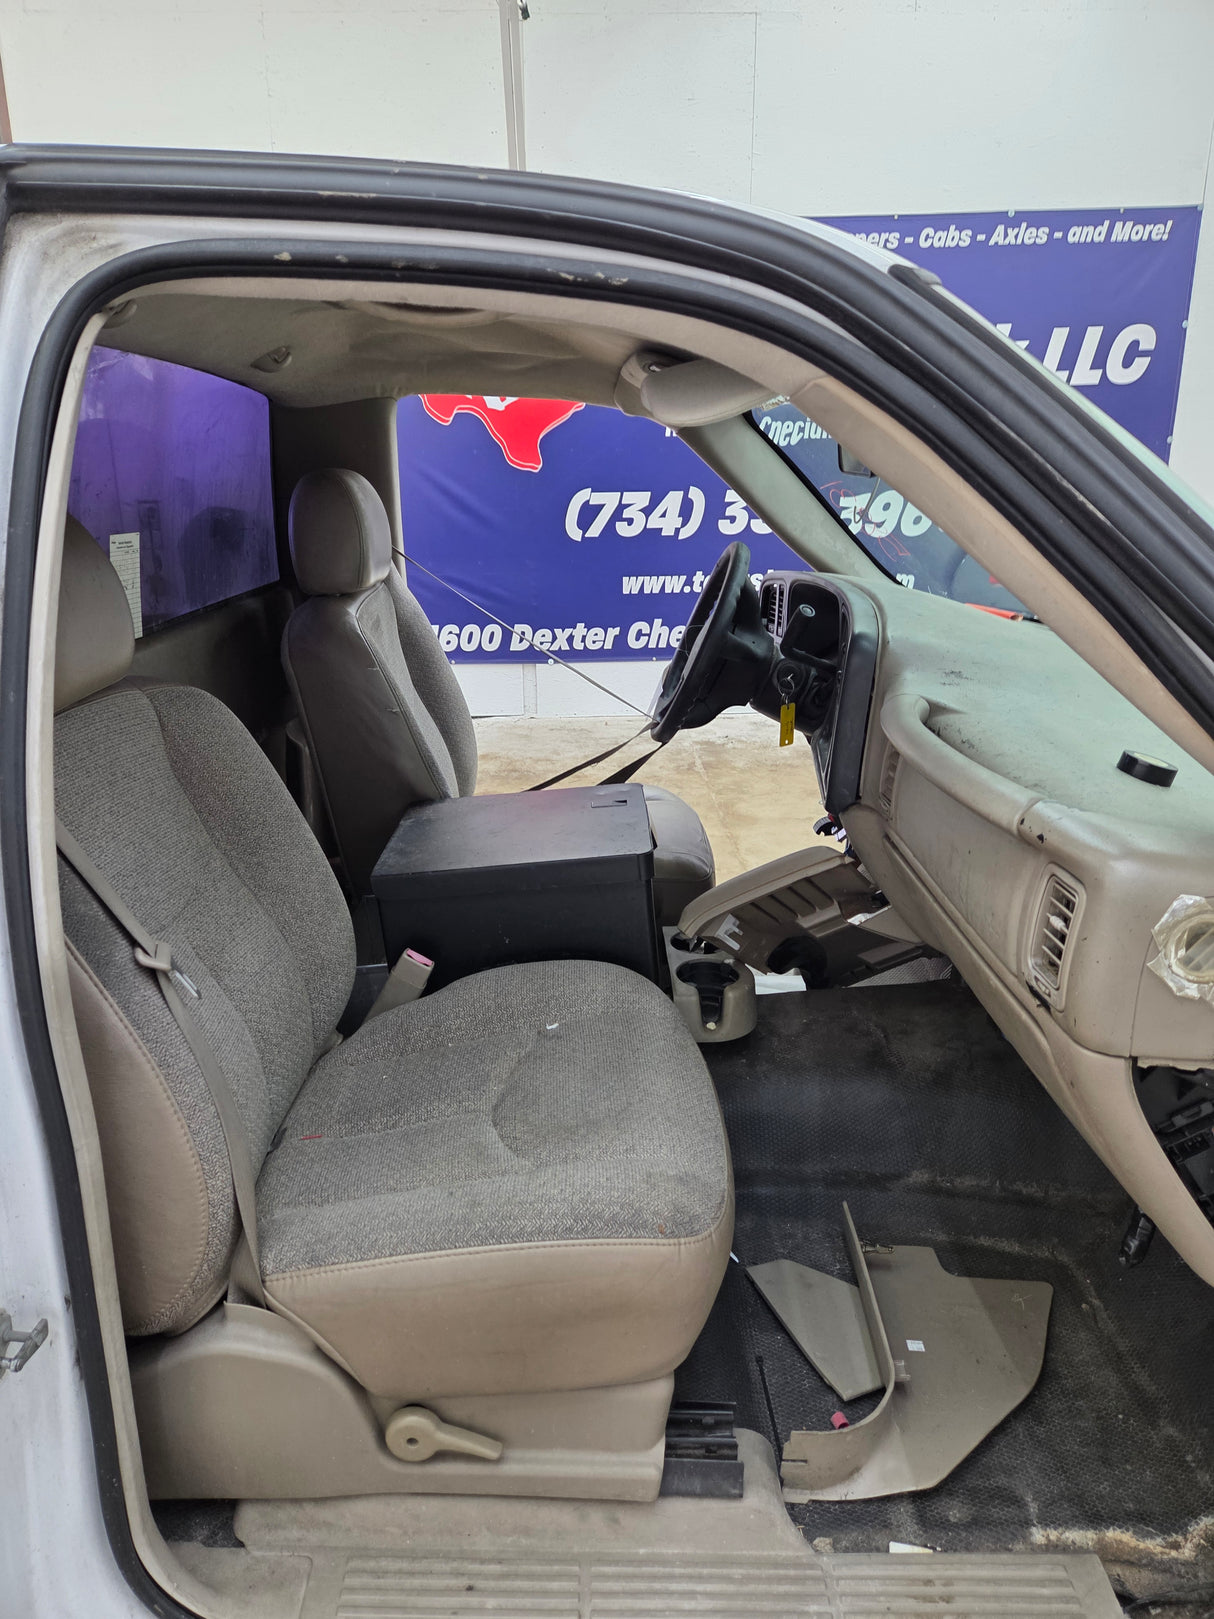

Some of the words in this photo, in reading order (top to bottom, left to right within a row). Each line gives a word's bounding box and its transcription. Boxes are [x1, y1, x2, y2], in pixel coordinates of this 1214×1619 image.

[919, 224, 971, 249] Cabs
[989, 222, 1049, 246] Axles
[1067, 220, 1109, 243] and
[1111, 220, 1173, 242] More!
[1042, 323, 1157, 386] LLC
[565, 486, 706, 541] (734)
[510, 623, 620, 651] Dexter
